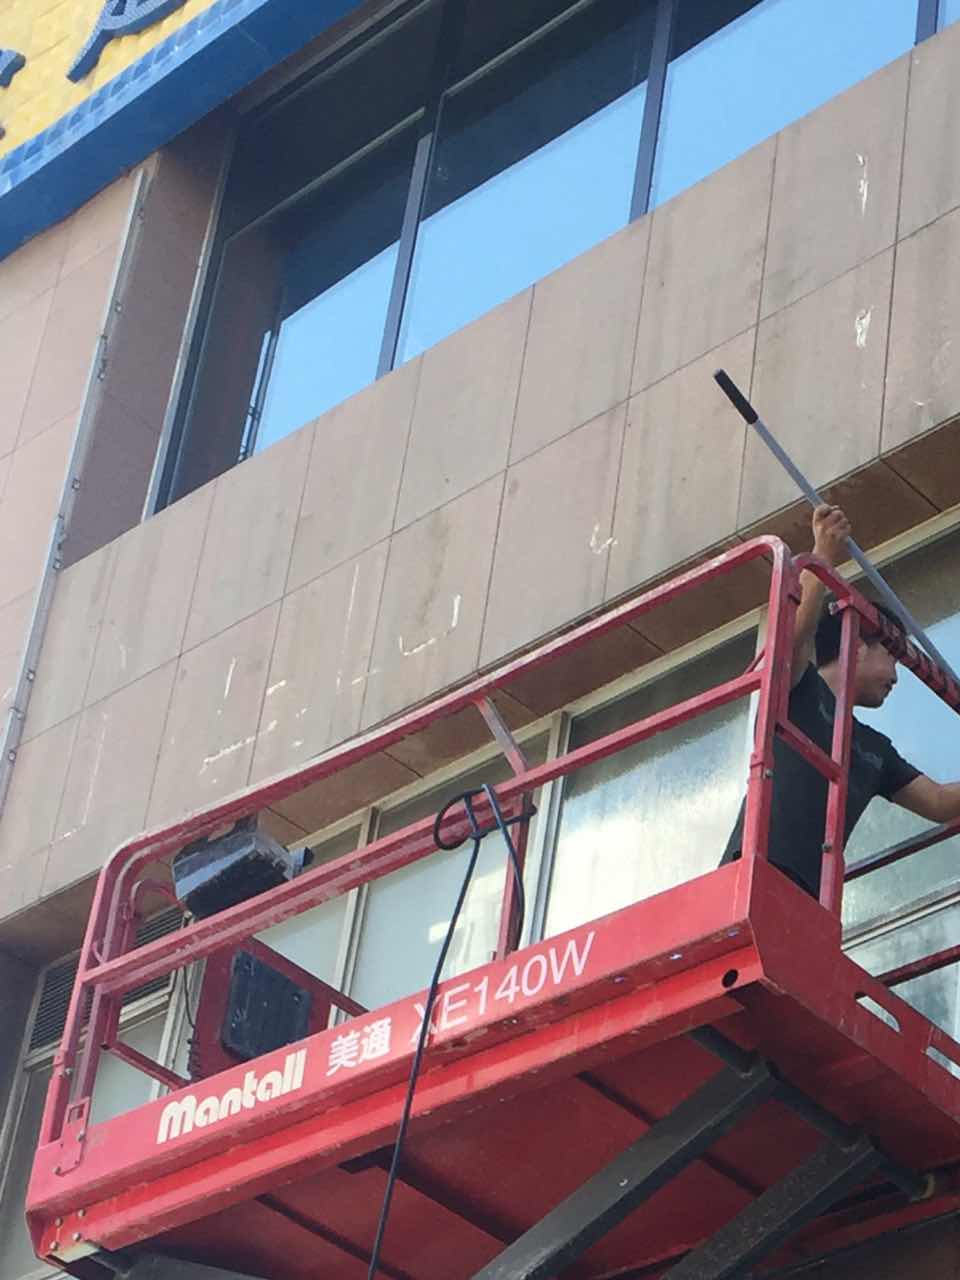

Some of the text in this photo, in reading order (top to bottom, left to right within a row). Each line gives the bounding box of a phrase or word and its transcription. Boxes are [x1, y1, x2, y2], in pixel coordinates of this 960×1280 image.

[157, 931, 596, 1145] Mantall 美通 XE140W
